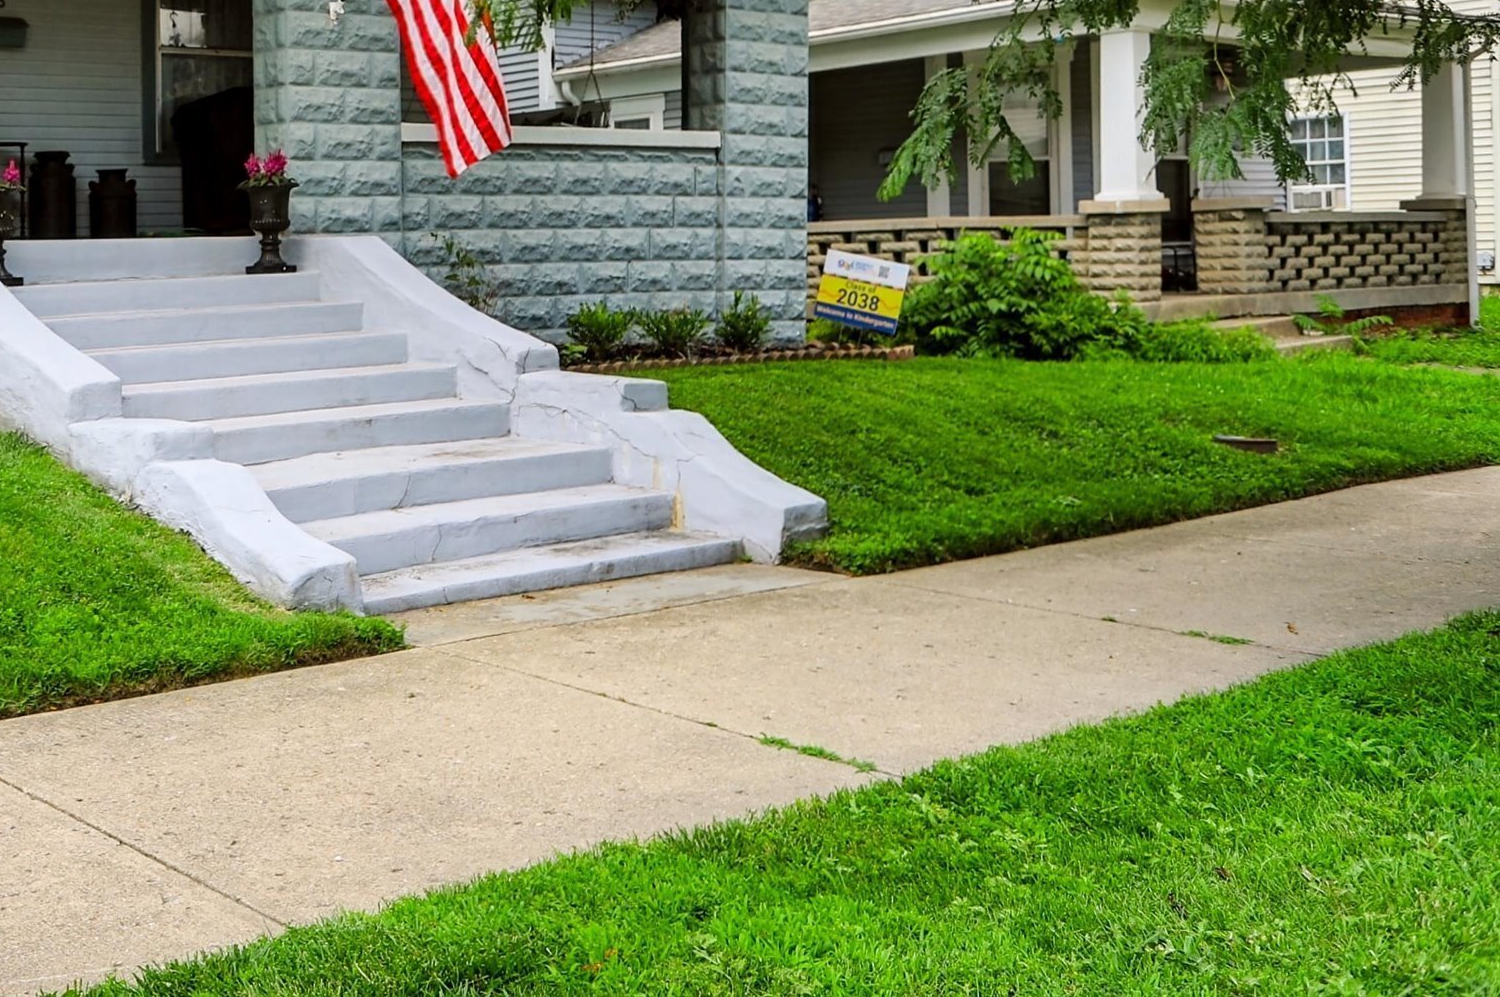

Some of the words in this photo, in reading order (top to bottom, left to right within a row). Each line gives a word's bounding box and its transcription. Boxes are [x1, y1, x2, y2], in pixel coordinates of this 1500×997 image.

[846, 281, 866, 292] Class
[868, 285, 876, 293] of
[836, 288, 880, 311] 2038
[817, 305, 845, 317] Welcome
[854, 313, 894, 328] Kindergarten
